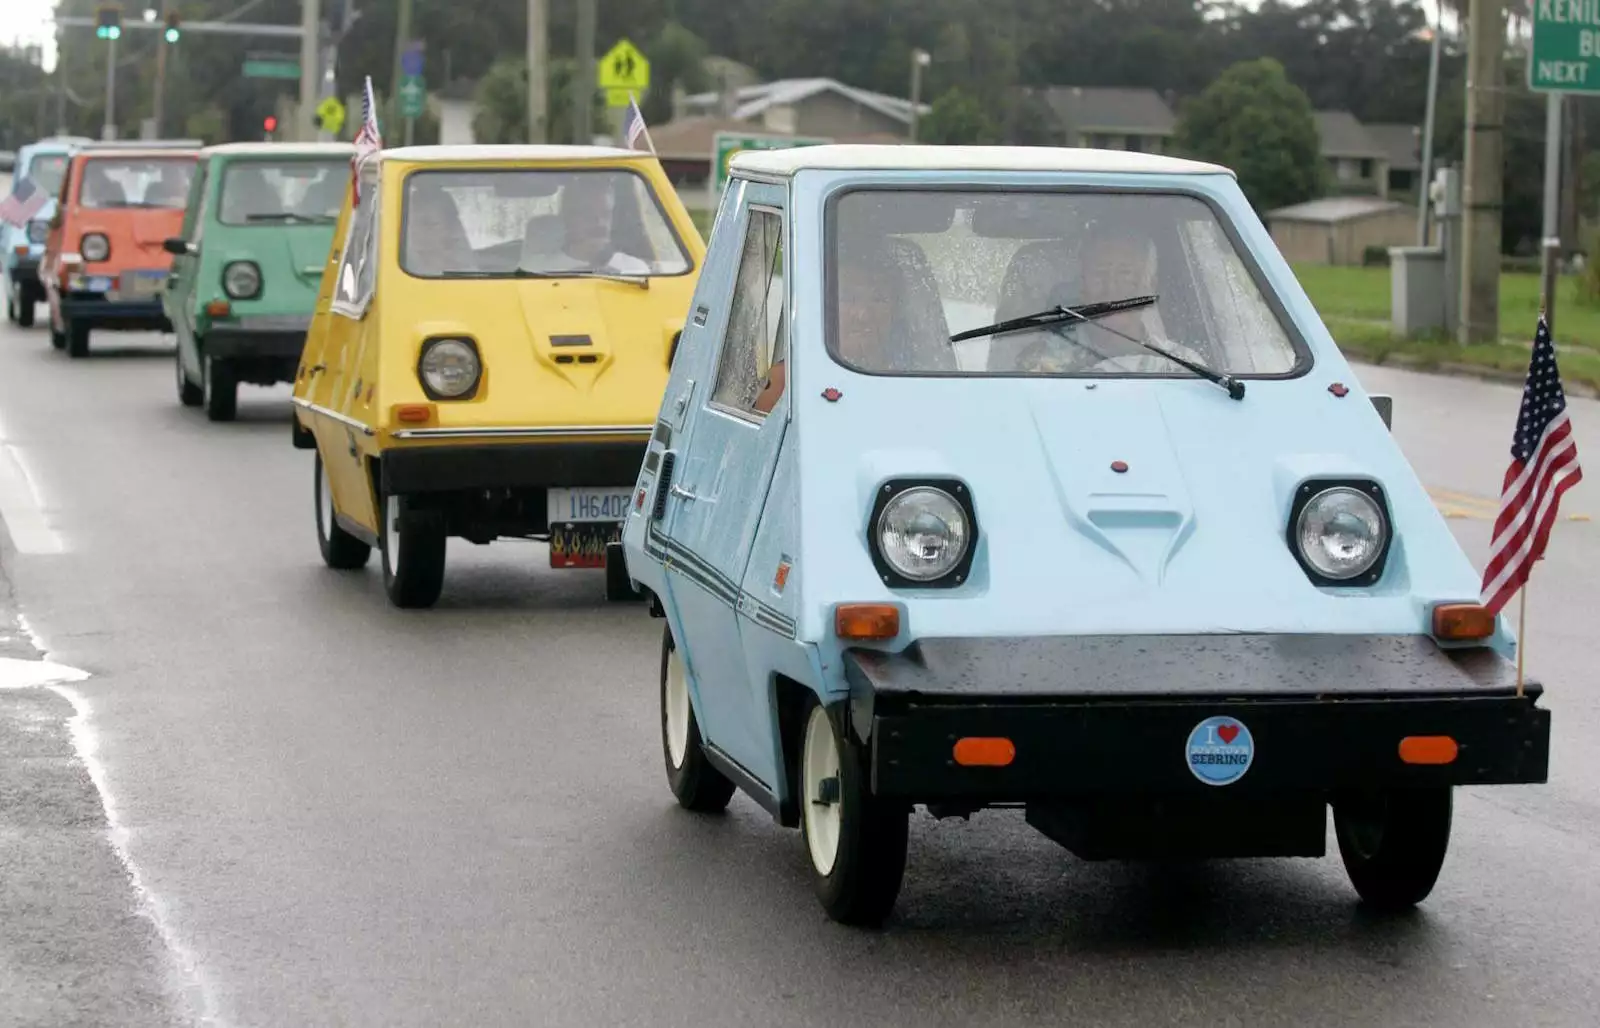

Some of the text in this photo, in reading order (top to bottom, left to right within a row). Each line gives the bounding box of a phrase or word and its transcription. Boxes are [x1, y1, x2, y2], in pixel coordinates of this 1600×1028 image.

[1539, 60, 1588, 83] NEXT
[1205, 725, 1216, 744] I
[1191, 754, 1247, 765] SEBRING
